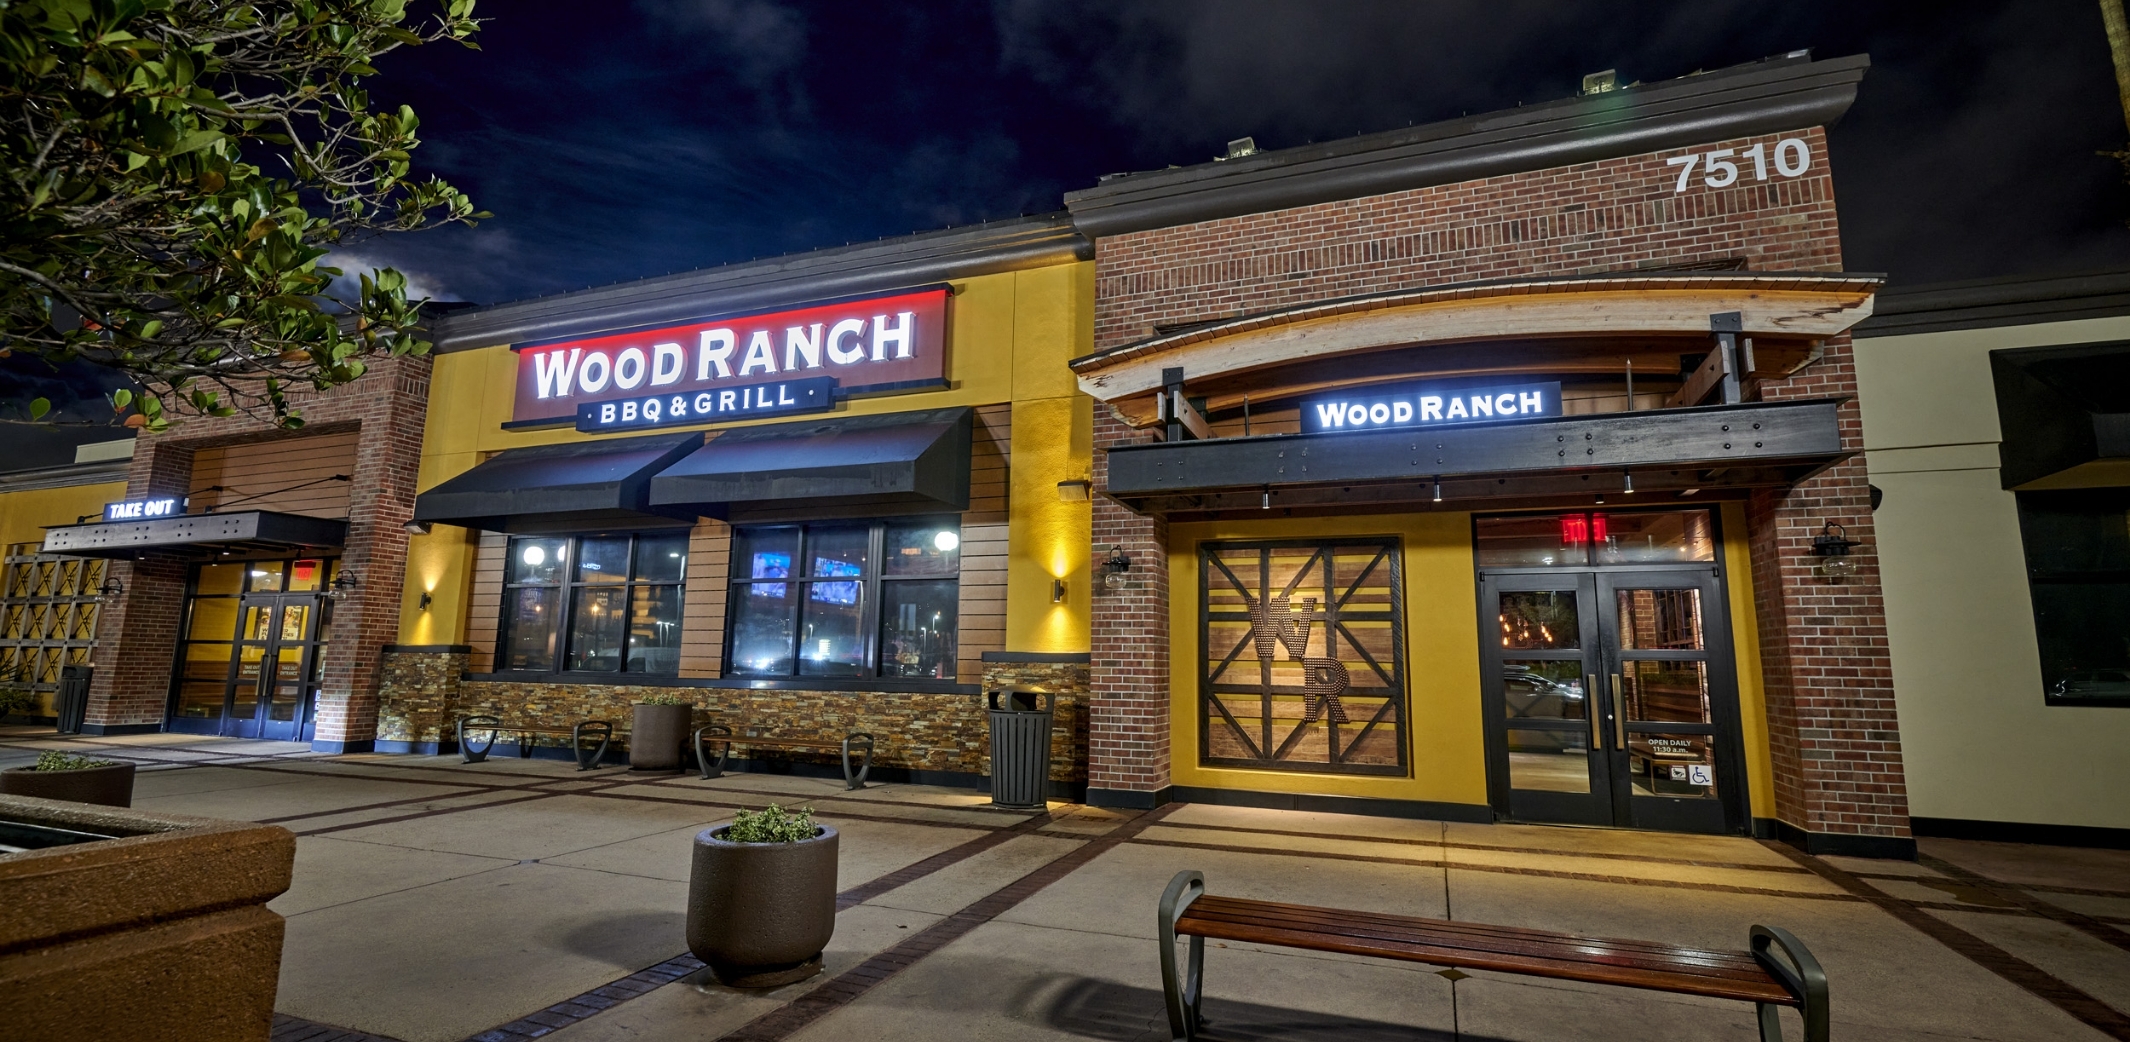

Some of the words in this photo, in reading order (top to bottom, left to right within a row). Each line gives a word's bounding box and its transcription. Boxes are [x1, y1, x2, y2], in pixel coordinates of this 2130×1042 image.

[1667, 138, 1811, 193] 7510
[534, 342, 686, 399] WOOD
[696, 311, 916, 382] RANCH
[600, 398, 662, 424] BBQ
[669, 395, 688, 418] &
[694, 385, 796, 414] GRILL
[1316, 401, 1413, 429] WOOD
[1420, 391, 1543, 421] RANCH
[110, 502, 143, 519] TAKE
[144, 499, 175, 516] OUT
